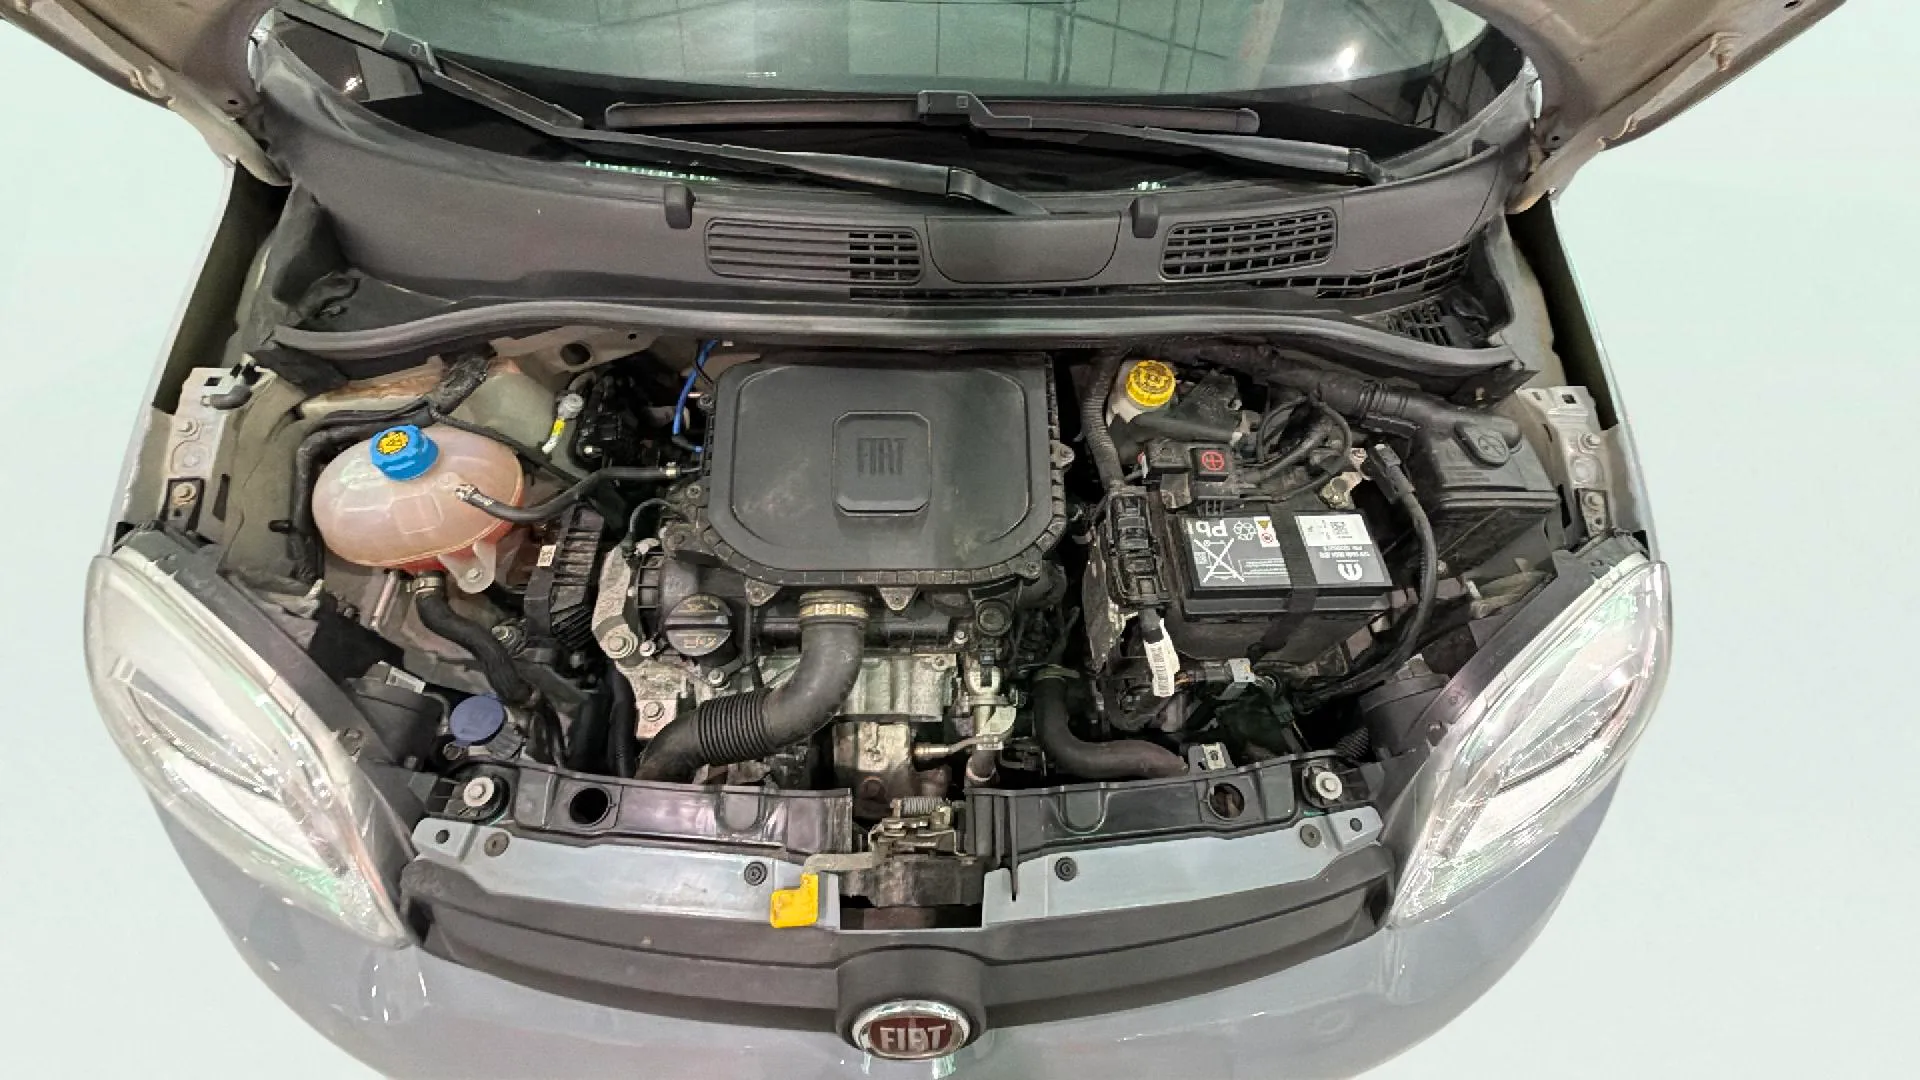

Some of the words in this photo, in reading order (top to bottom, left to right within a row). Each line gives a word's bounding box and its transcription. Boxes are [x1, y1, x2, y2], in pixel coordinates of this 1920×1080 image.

[857, 436, 907, 475] FIAT
[1196, 519, 1228, 537] Pb
[880, 1024, 946, 1052] FIAT
